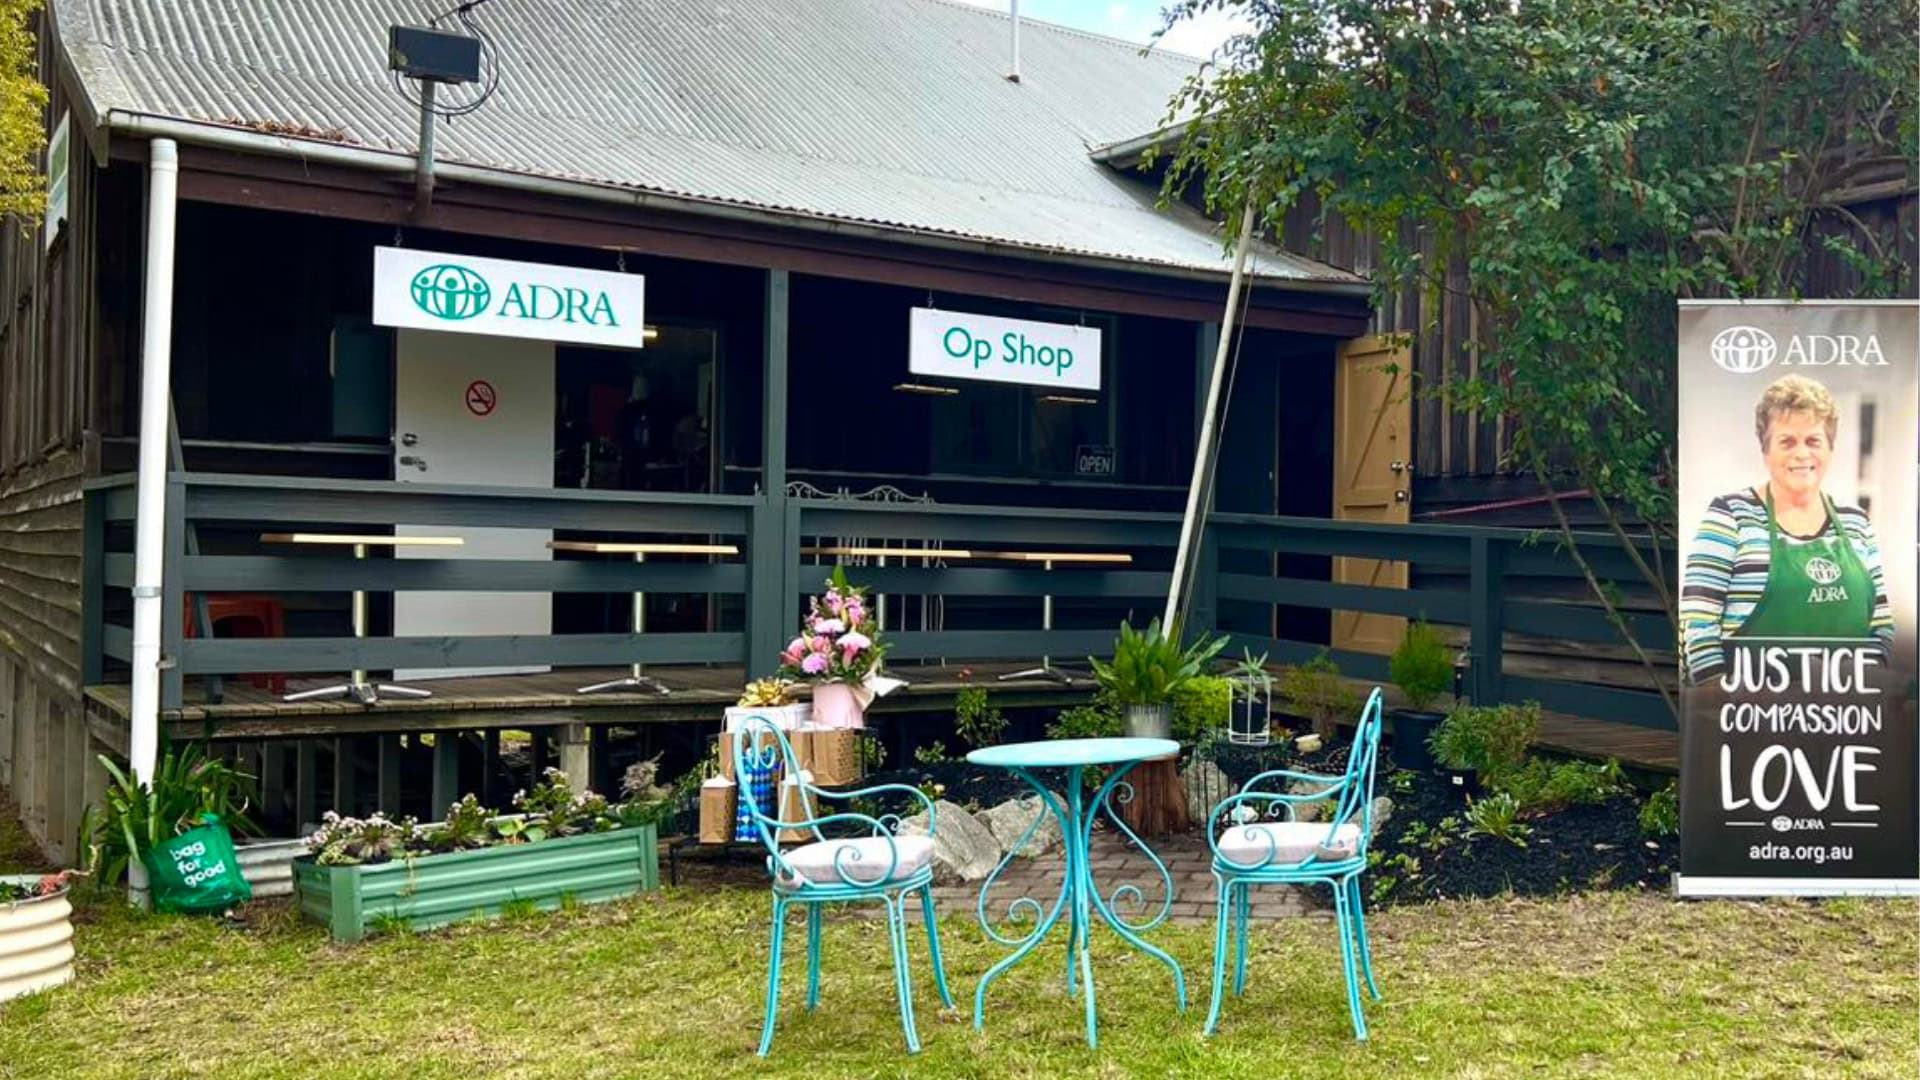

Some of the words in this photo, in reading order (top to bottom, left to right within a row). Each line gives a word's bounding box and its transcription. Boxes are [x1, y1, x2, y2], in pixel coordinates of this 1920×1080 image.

[496, 282, 621, 327] ADRA
[943, 327, 992, 368] Op
[1002, 332, 1073, 376] Shop
[1780, 335, 1889, 366] ADRA
[1079, 455, 1111, 473] OPEN
[1807, 587, 1848, 603] ADRA
[1721, 648, 1881, 693] JUSTICE
[1721, 703, 1881, 734] COMPASSION
[1720, 743, 1881, 812] LOVE
[1793, 818, 1825, 830] ADRA
[169, 842, 205, 860] bag
[1750, 843, 1852, 863] adra.org.au
[177, 859, 201, 874] for
[184, 860, 226, 887] good
